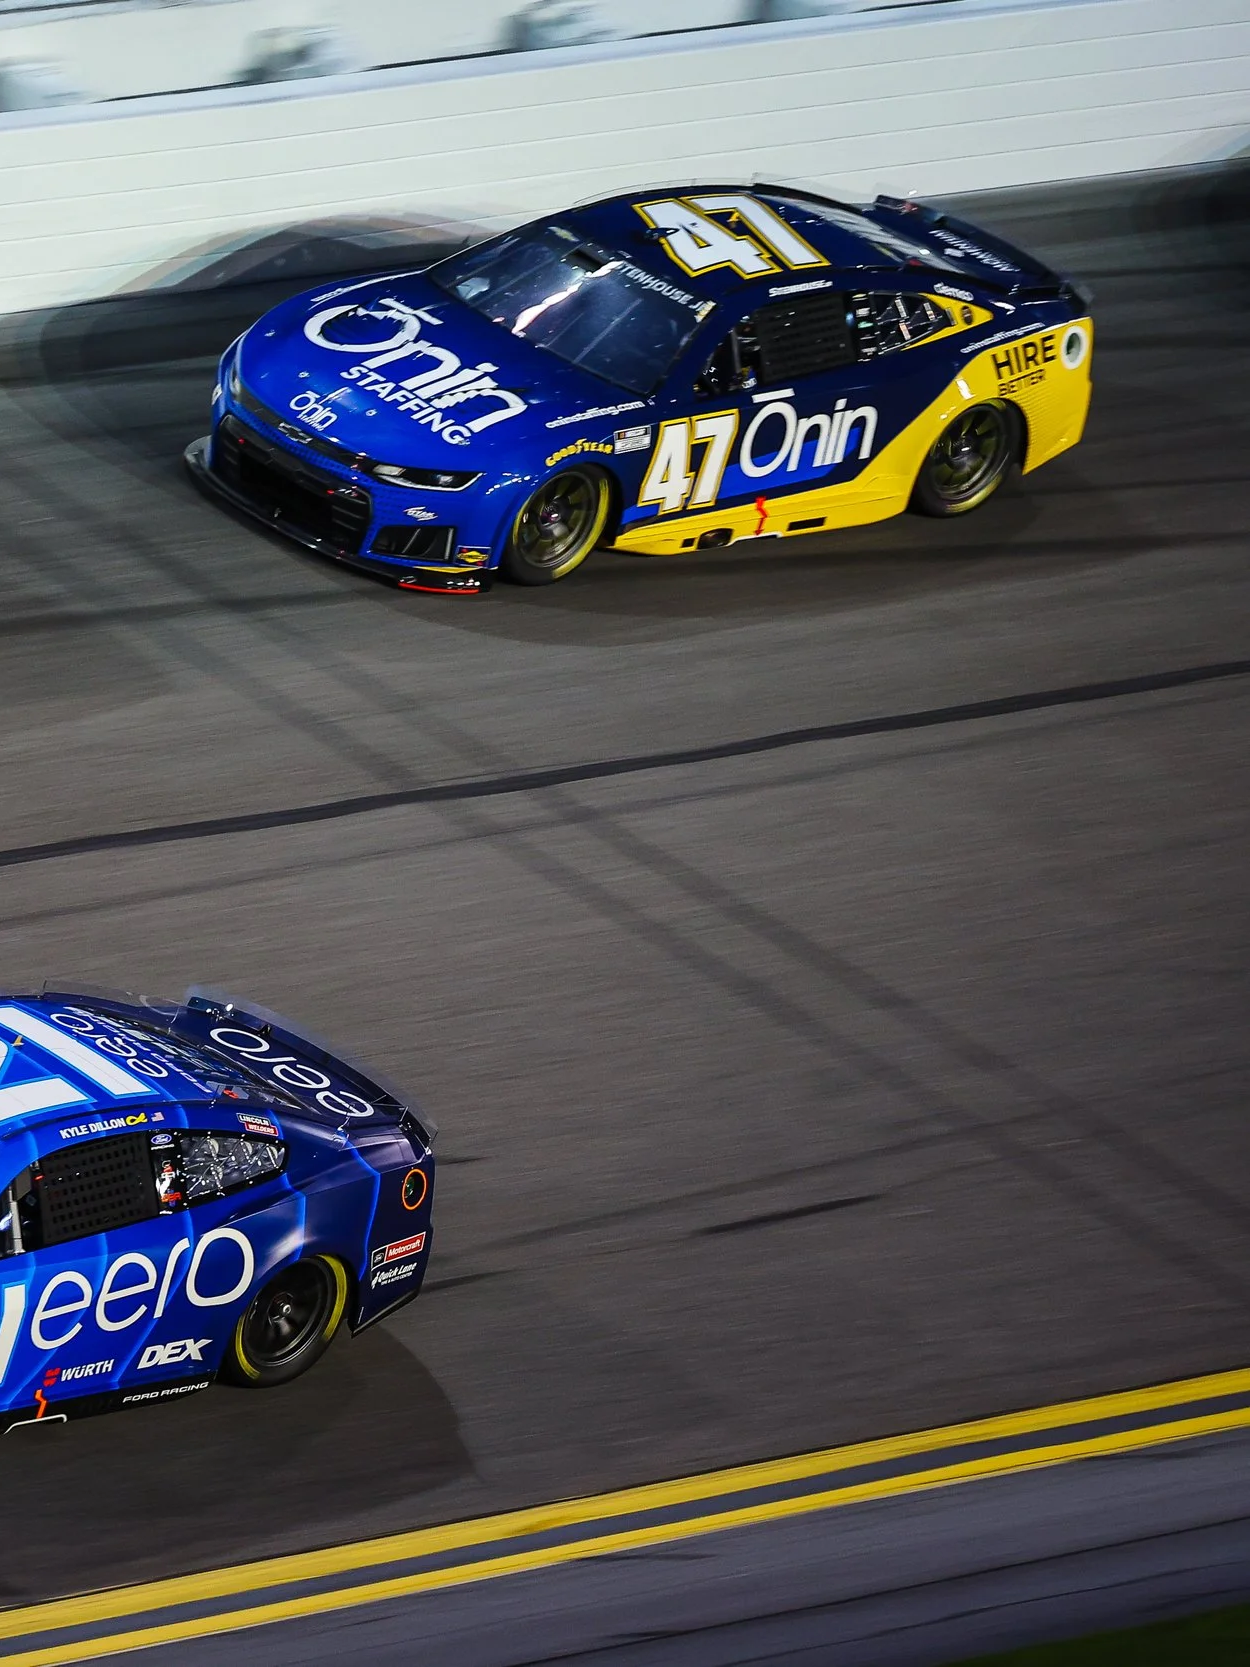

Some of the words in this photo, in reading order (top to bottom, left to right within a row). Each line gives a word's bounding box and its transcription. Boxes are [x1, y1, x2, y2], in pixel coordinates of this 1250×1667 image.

[632, 193, 832, 279] 47
[617, 261, 695, 305] TENHOUSE
[991, 334, 1056, 380] HIRE
[998, 368, 1047, 397] BETTER
[340, 365, 472, 446] STAFFING
[545, 438, 614, 467] GOODYEAR
[637, 408, 739, 516] 47
[50, 1013, 169, 1078] eero
[209, 1027, 375, 1118] eero
[59, 1124, 90, 1140] KYLE
[88, 1117, 127, 1133] DILLON
[239, 1114, 270, 1126] LINCOLN
[248, 1122, 276, 1135] WELDERS
[388, 1239, 421, 1257] Motorcraft
[398, 1262, 418, 1276] Lane
[30, 1228, 254, 1349] eero
[137, 1338, 213, 1369] DEX
[60, 1359, 115, 1382] WÜRTH
[123, 1391, 159, 1403] FORD
[160, 1382, 209, 1396] RACING
